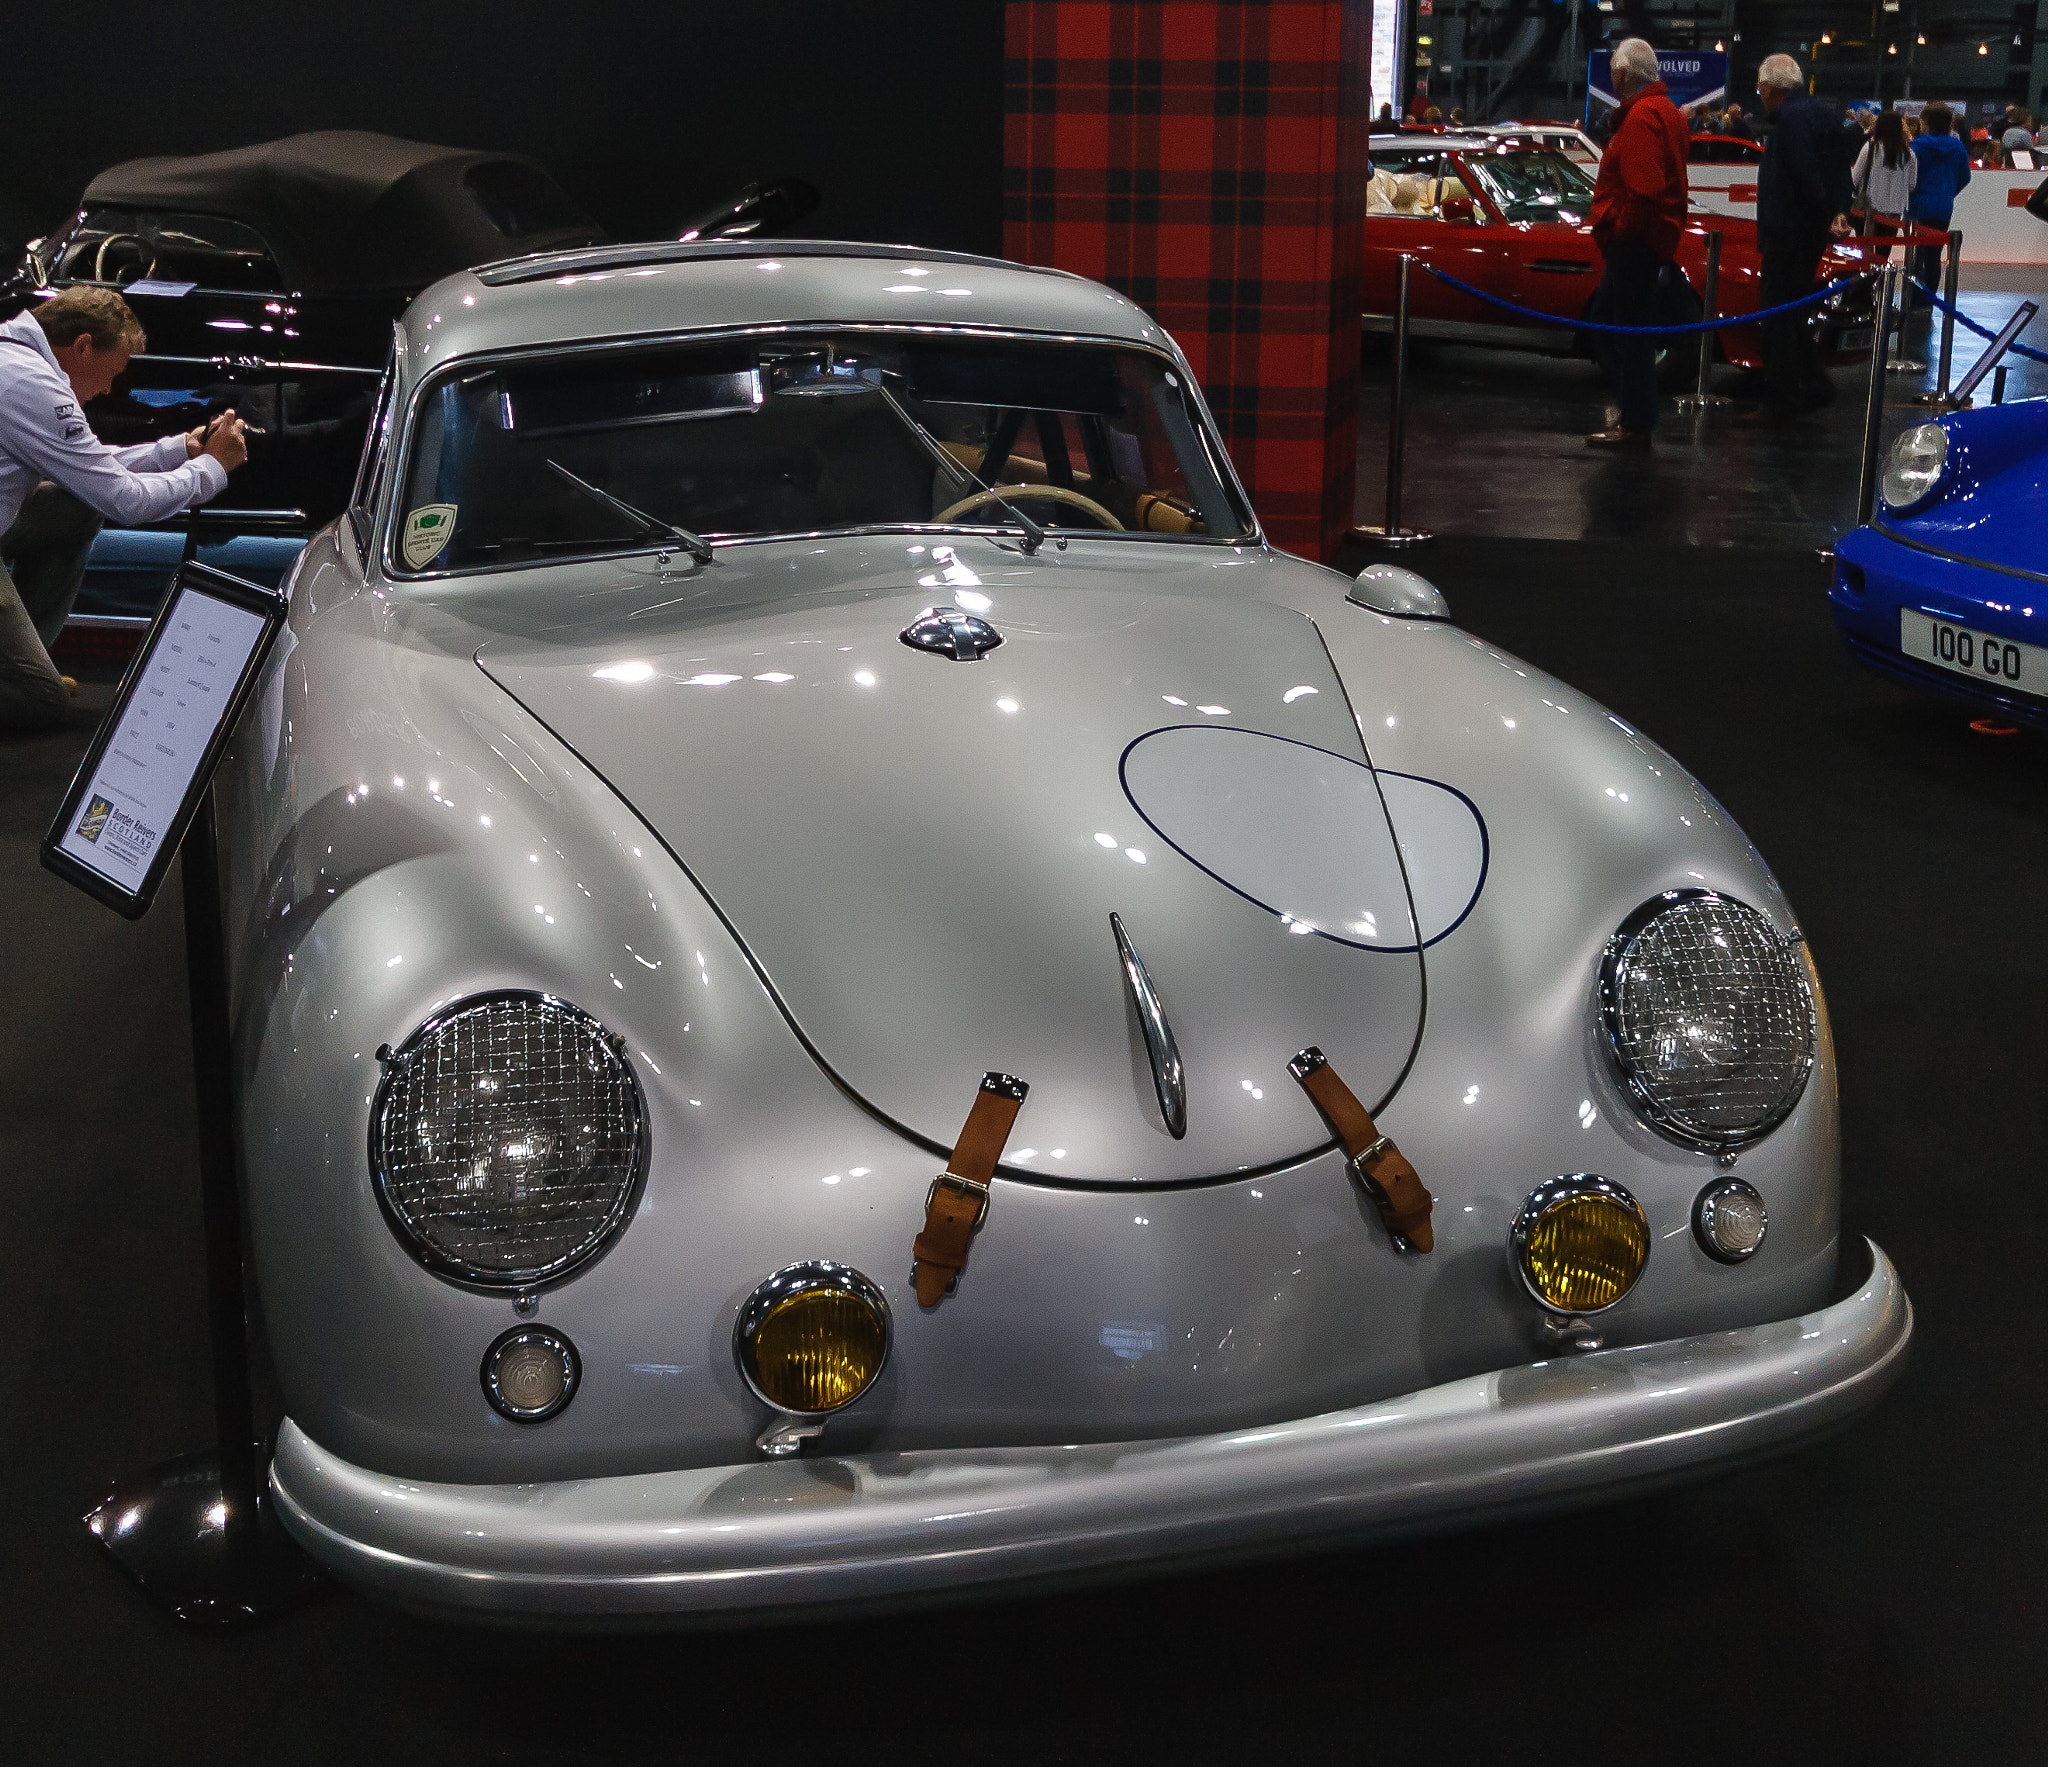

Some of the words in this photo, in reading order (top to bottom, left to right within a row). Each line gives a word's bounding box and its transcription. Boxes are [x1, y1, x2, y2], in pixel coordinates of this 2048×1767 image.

[1932, 622, 1974, 668] 100
[1982, 639, 2021, 681] GO
[108, 820, 152, 849] SCOTLAND
[112, 808, 135, 828] Border
[133, 820, 157, 841] Reivers
